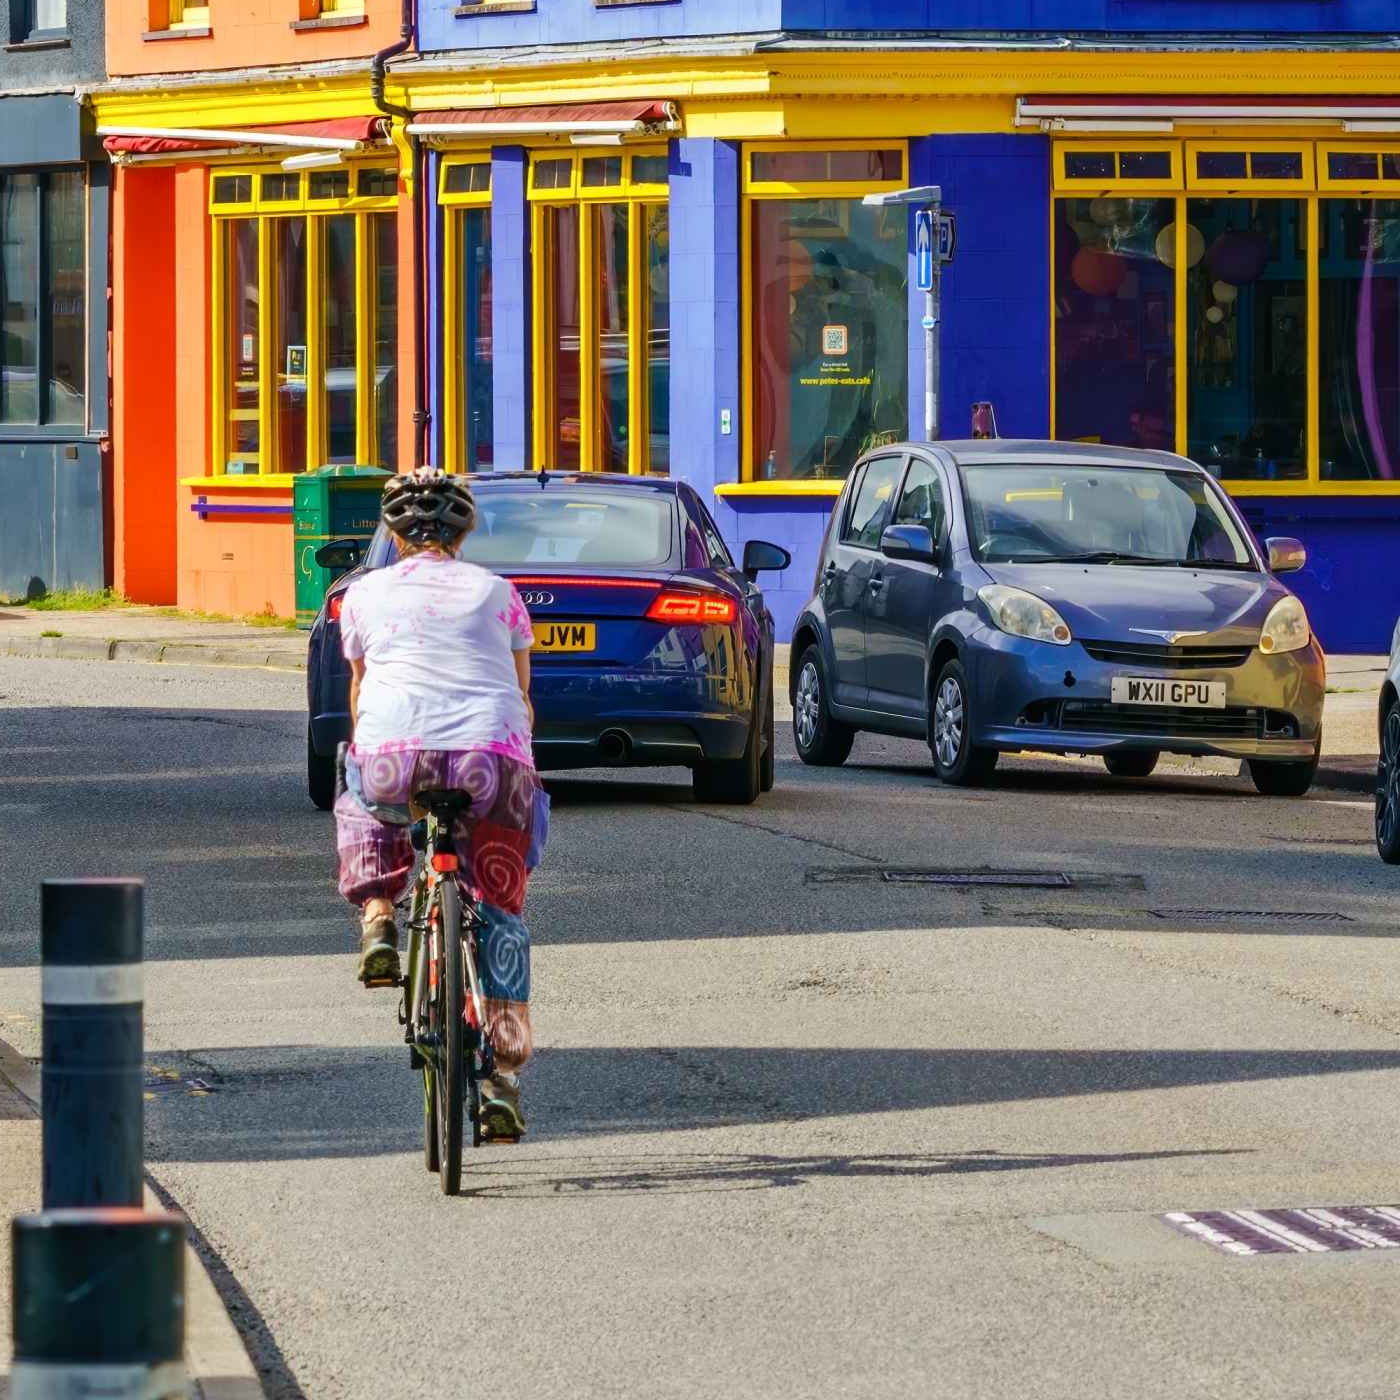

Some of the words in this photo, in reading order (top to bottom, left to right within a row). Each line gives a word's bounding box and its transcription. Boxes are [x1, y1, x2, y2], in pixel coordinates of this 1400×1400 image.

[540, 626, 586, 646] JVM
[1128, 681, 1165, 701] WX11
[1170, 683, 1209, 704] GPU
